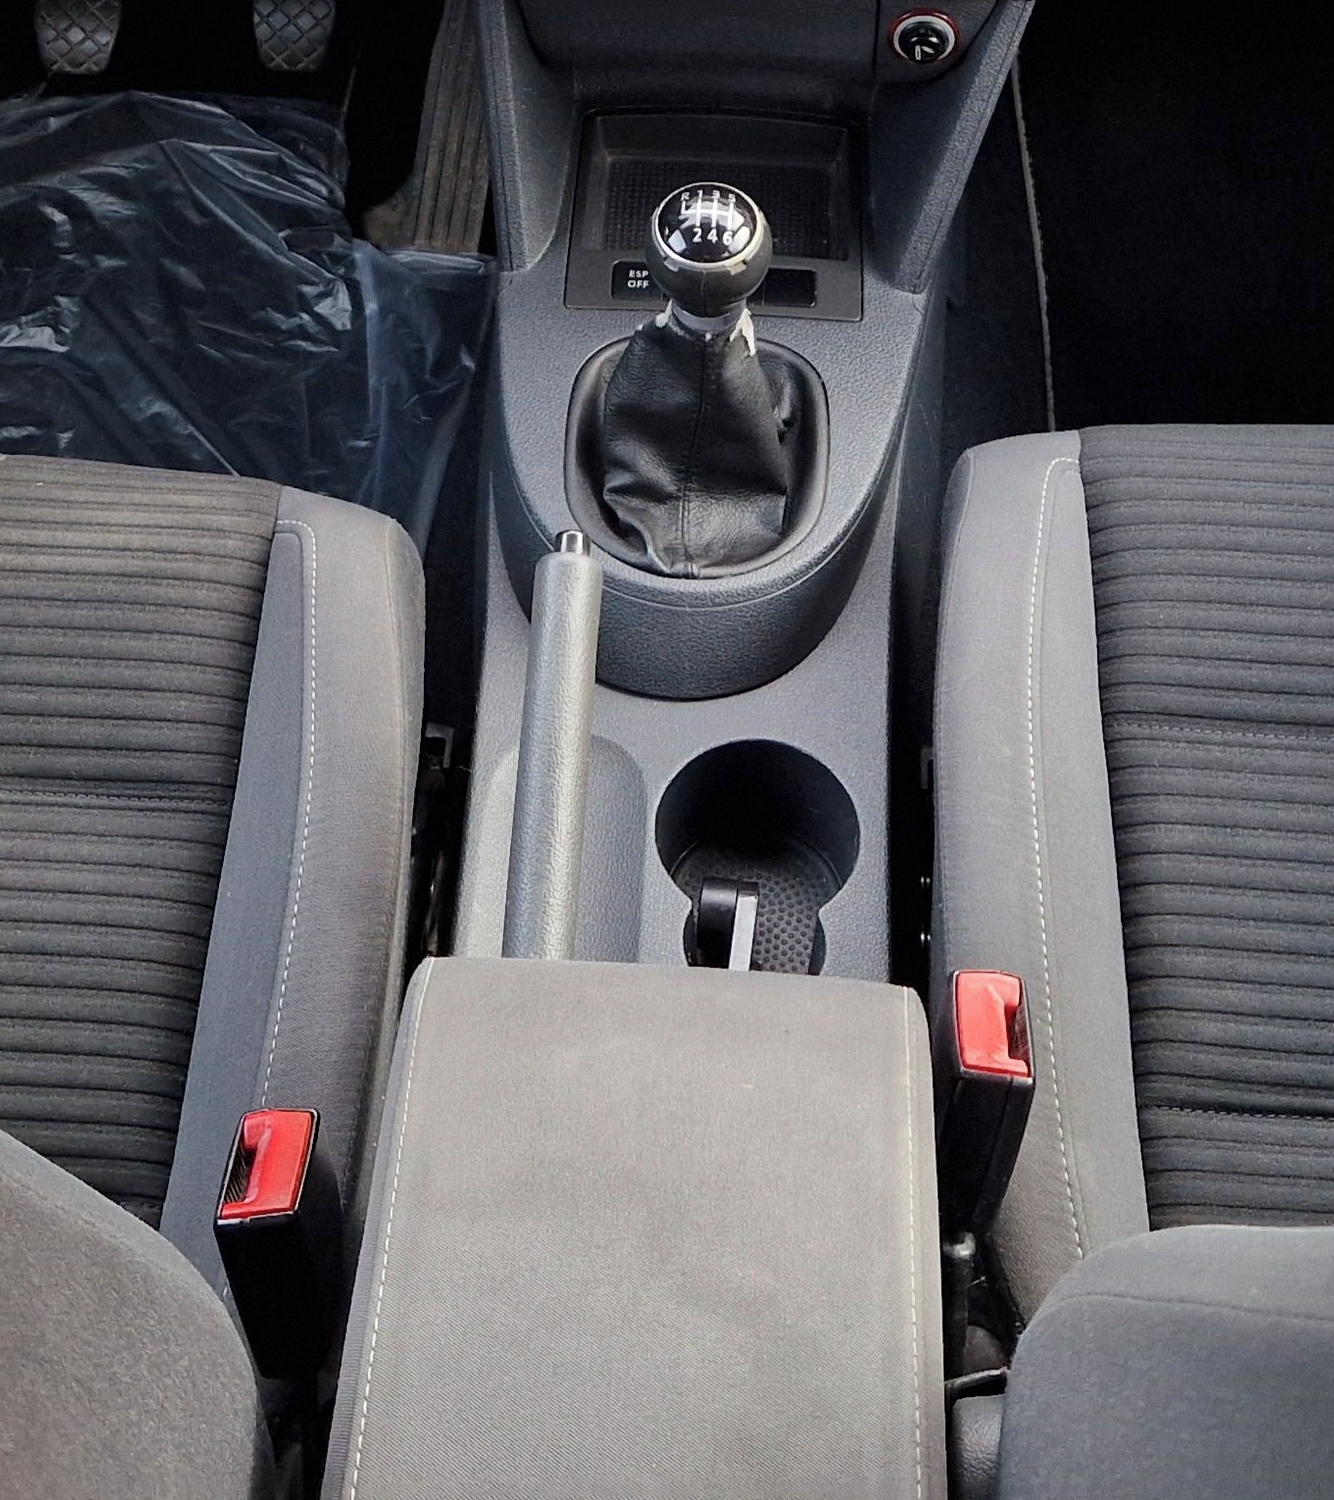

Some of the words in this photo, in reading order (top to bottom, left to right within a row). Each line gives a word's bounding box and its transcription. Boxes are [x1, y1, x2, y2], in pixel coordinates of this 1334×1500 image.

[692, 228, 703, 243] 2
[707, 228, 719, 244] 4
[722, 231, 734, 246] 6
[629, 269, 649, 278] ESP
[627, 280, 650, 289] OFF
